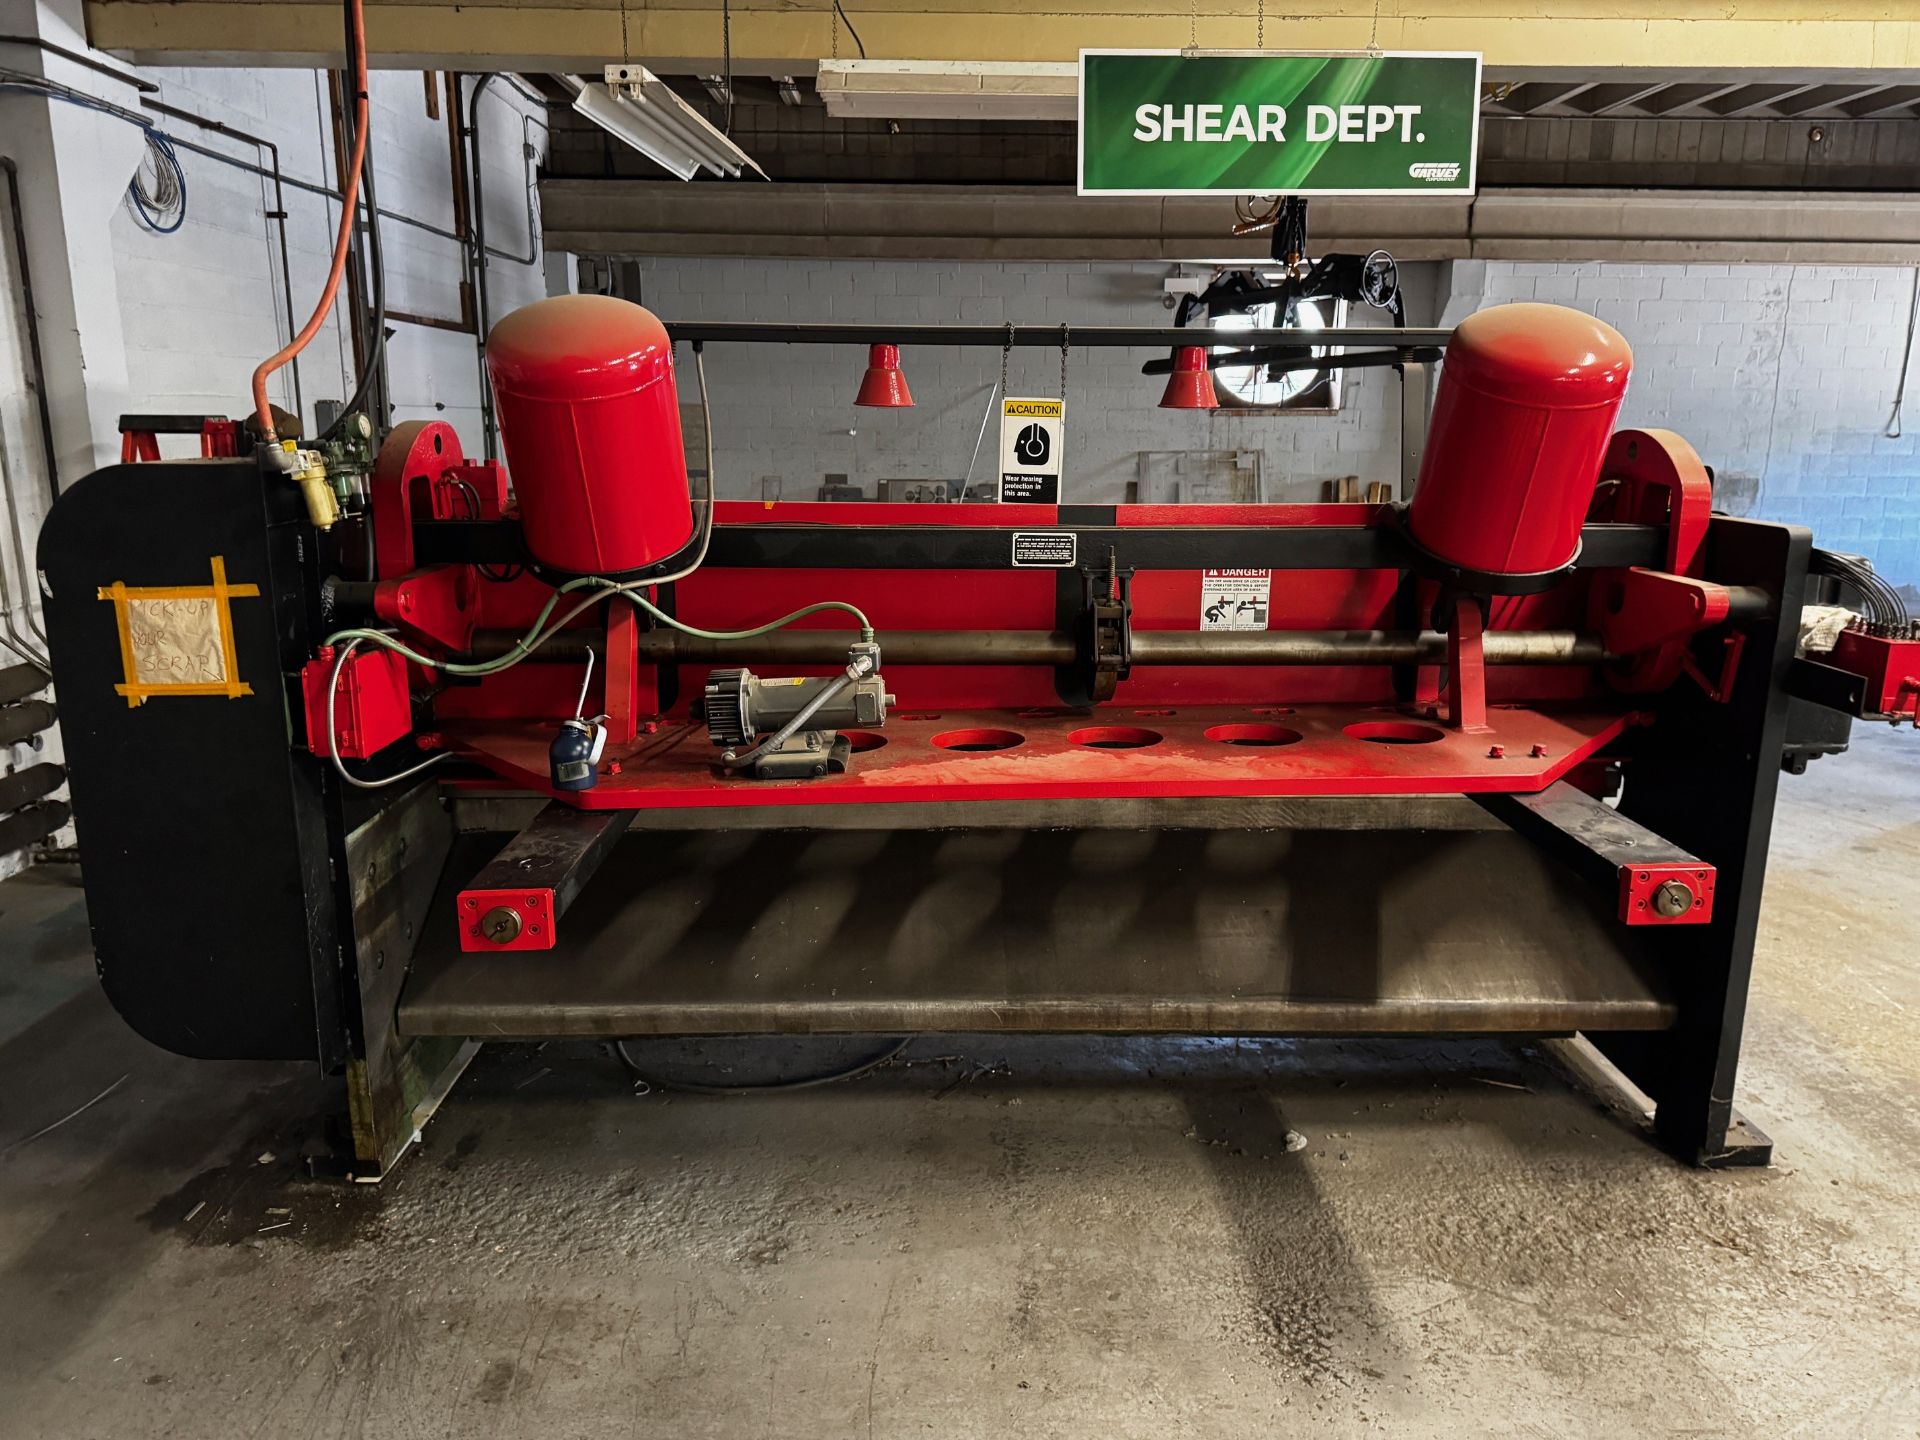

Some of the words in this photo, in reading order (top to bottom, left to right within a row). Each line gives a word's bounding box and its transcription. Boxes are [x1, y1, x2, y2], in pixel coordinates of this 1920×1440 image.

[1133, 103, 1287, 142] SHEAR
[1306, 104, 1426, 143] DEPT.
[1408, 162, 1462, 179] GARVEY
[1016, 404, 1059, 415] CAUTION
[1021, 475, 1043, 484] hearing
[130, 600, 209, 617] PICK-UP
[143, 655, 210, 672] SCRAP
